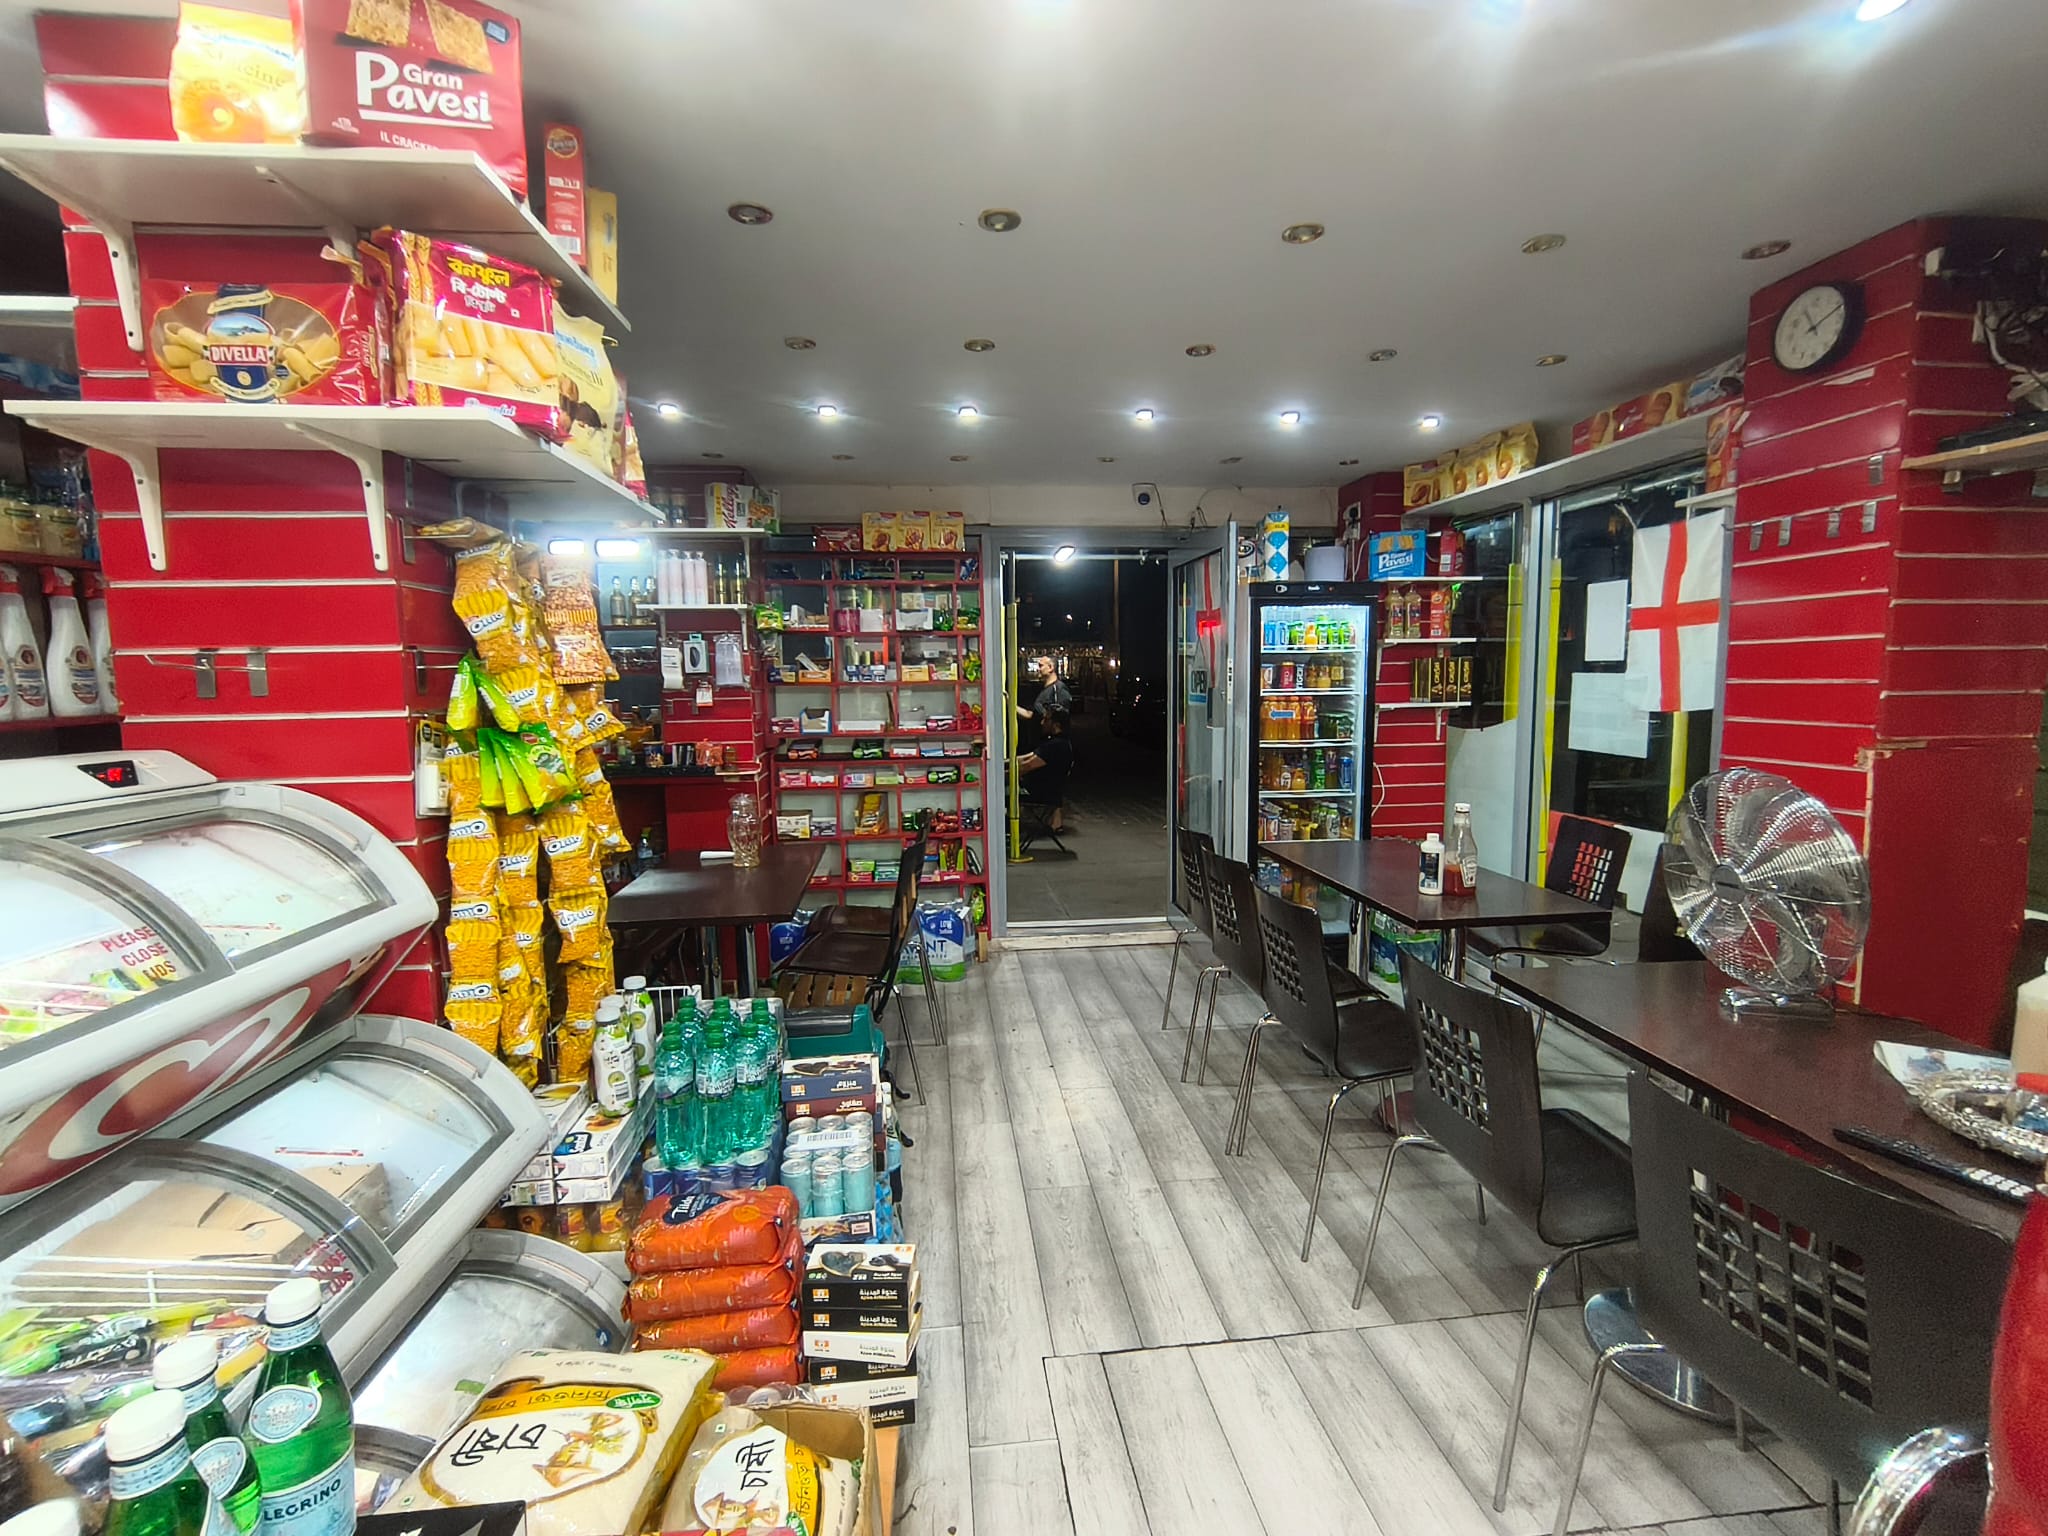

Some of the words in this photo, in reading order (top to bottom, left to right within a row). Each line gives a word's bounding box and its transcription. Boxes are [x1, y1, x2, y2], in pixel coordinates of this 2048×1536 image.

[354, 50, 492, 122] Pavesi
[402, 63, 463, 91] Gran
[211, 345, 268, 363] DIVELLA
[101, 926, 158, 952] PLEASE
[122, 942, 169, 967] CLOSE
[671, 1195, 696, 1219] Tilda
